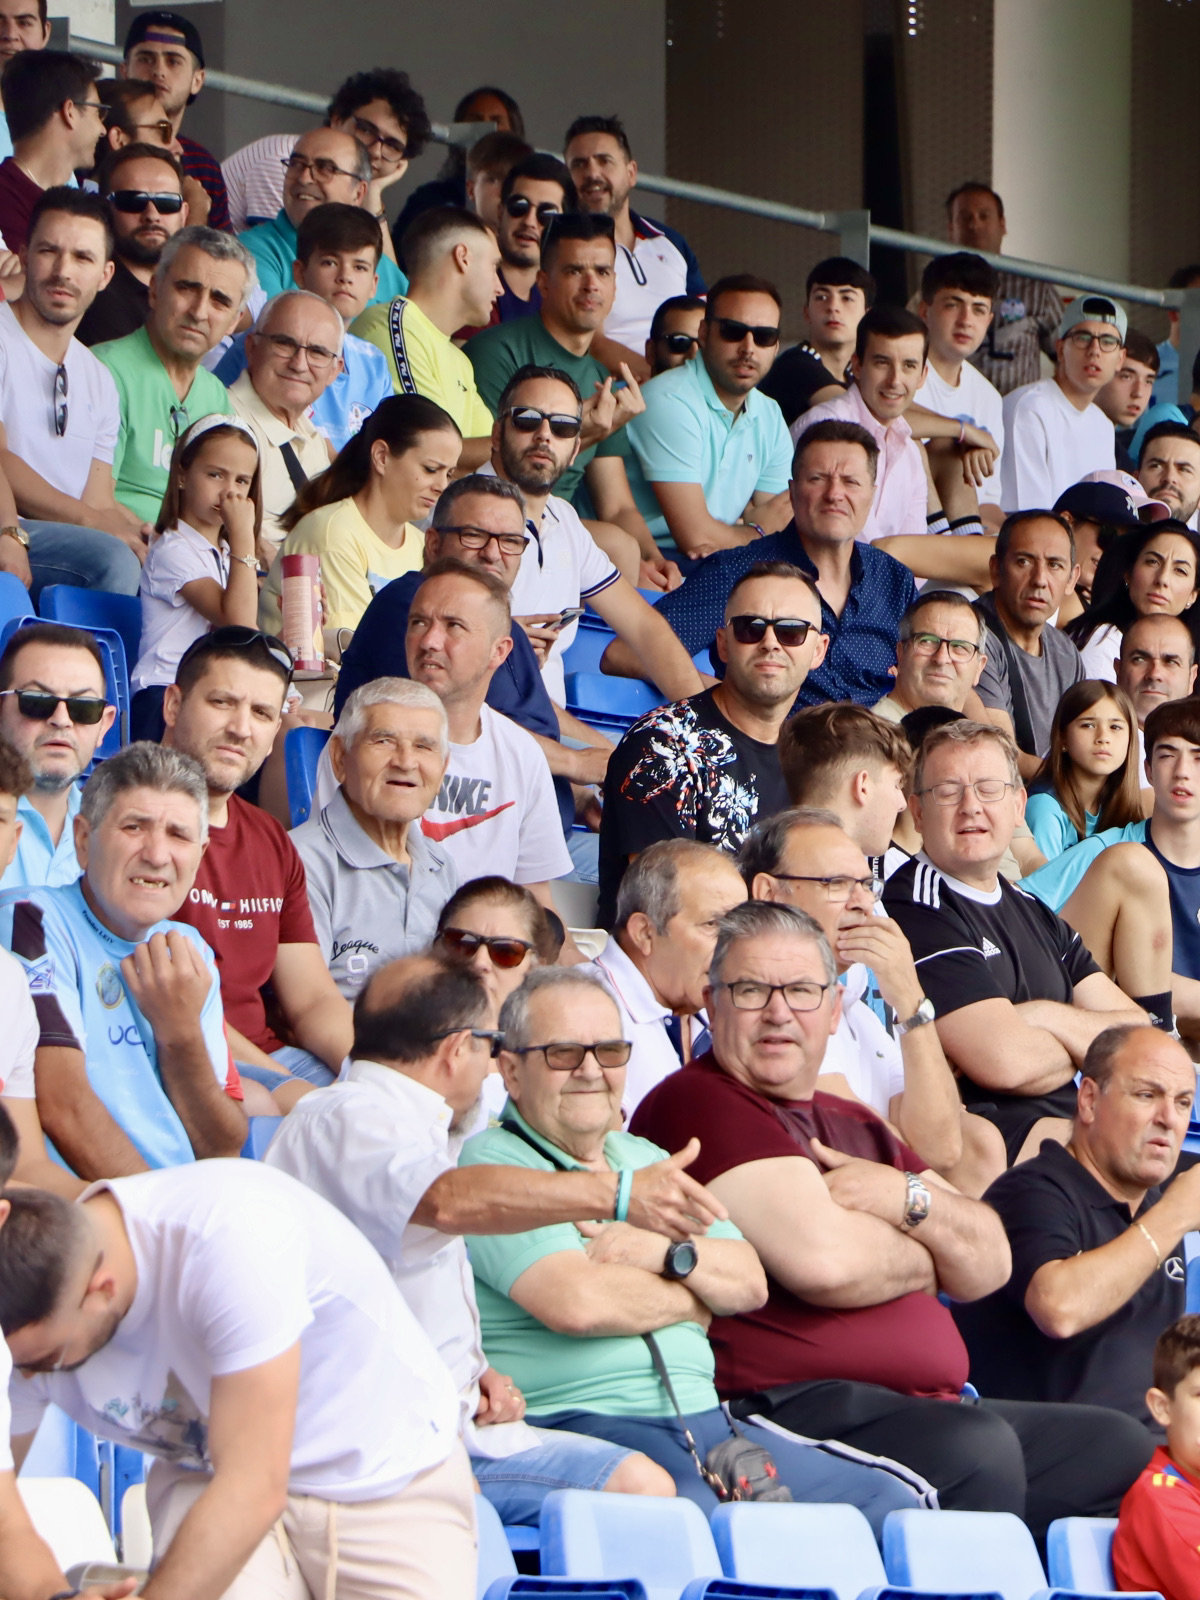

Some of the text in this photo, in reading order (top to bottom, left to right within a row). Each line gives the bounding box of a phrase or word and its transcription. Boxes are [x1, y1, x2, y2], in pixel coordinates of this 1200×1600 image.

[428, 774, 491, 815] NIKE
[240, 898, 284, 913] HILFIG
[234, 919, 254, 929] 1985
[331, 940, 379, 961] League
